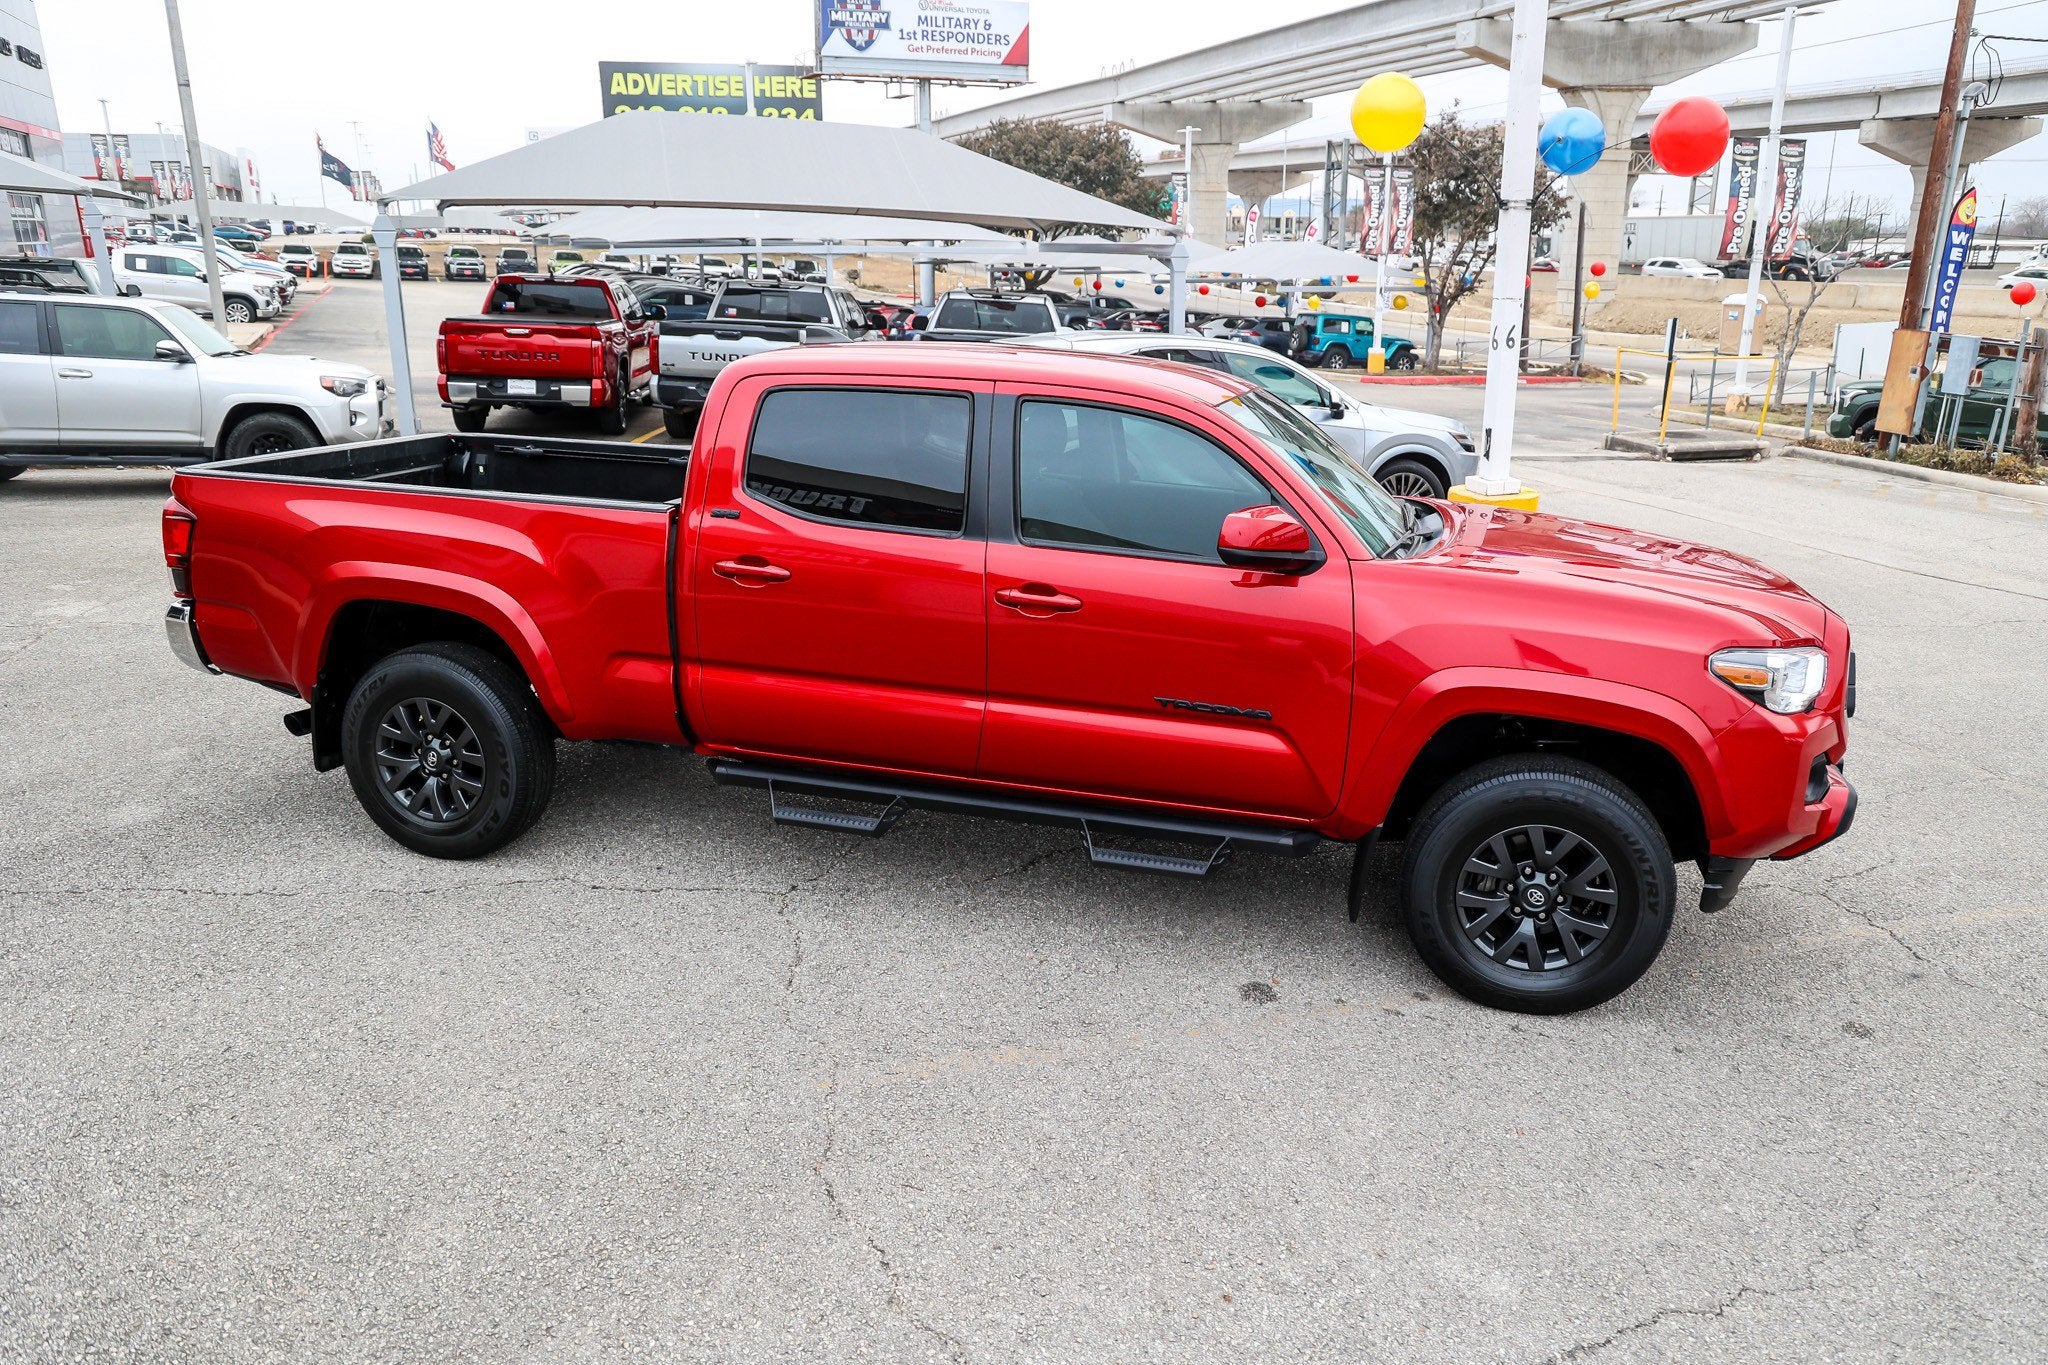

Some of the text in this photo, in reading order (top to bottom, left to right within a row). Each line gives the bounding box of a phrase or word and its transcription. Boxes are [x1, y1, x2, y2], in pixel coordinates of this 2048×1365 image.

[830, 10, 888, 23] MILITARY
[929, 5, 965, 13] UNIVERSAL
[917, 15, 992, 31] MILITARY &
[899, 28, 1010, 46] 1st RESPONDERS
[907, 44, 1002, 59] Get Preferred Pricing
[610, 72, 817, 99] ADVERTISE HERE
[1732, 166, 1752, 224] Owned
[1778, 167, 1798, 224] Owned
[1367, 185, 1380, 228] Owned
[1396, 186, 1408, 228] Owned
[1365, 228, 1378, 250] Pre
[1393, 228, 1406, 250] Pre
[1726, 226, 1744, 254] Pre
[1771, 226, 1789, 254] Pre
[475, 349, 560, 362] TUNDRA
[687, 351, 749, 362] TUND
[1154, 696, 1272, 721] TACOMA
